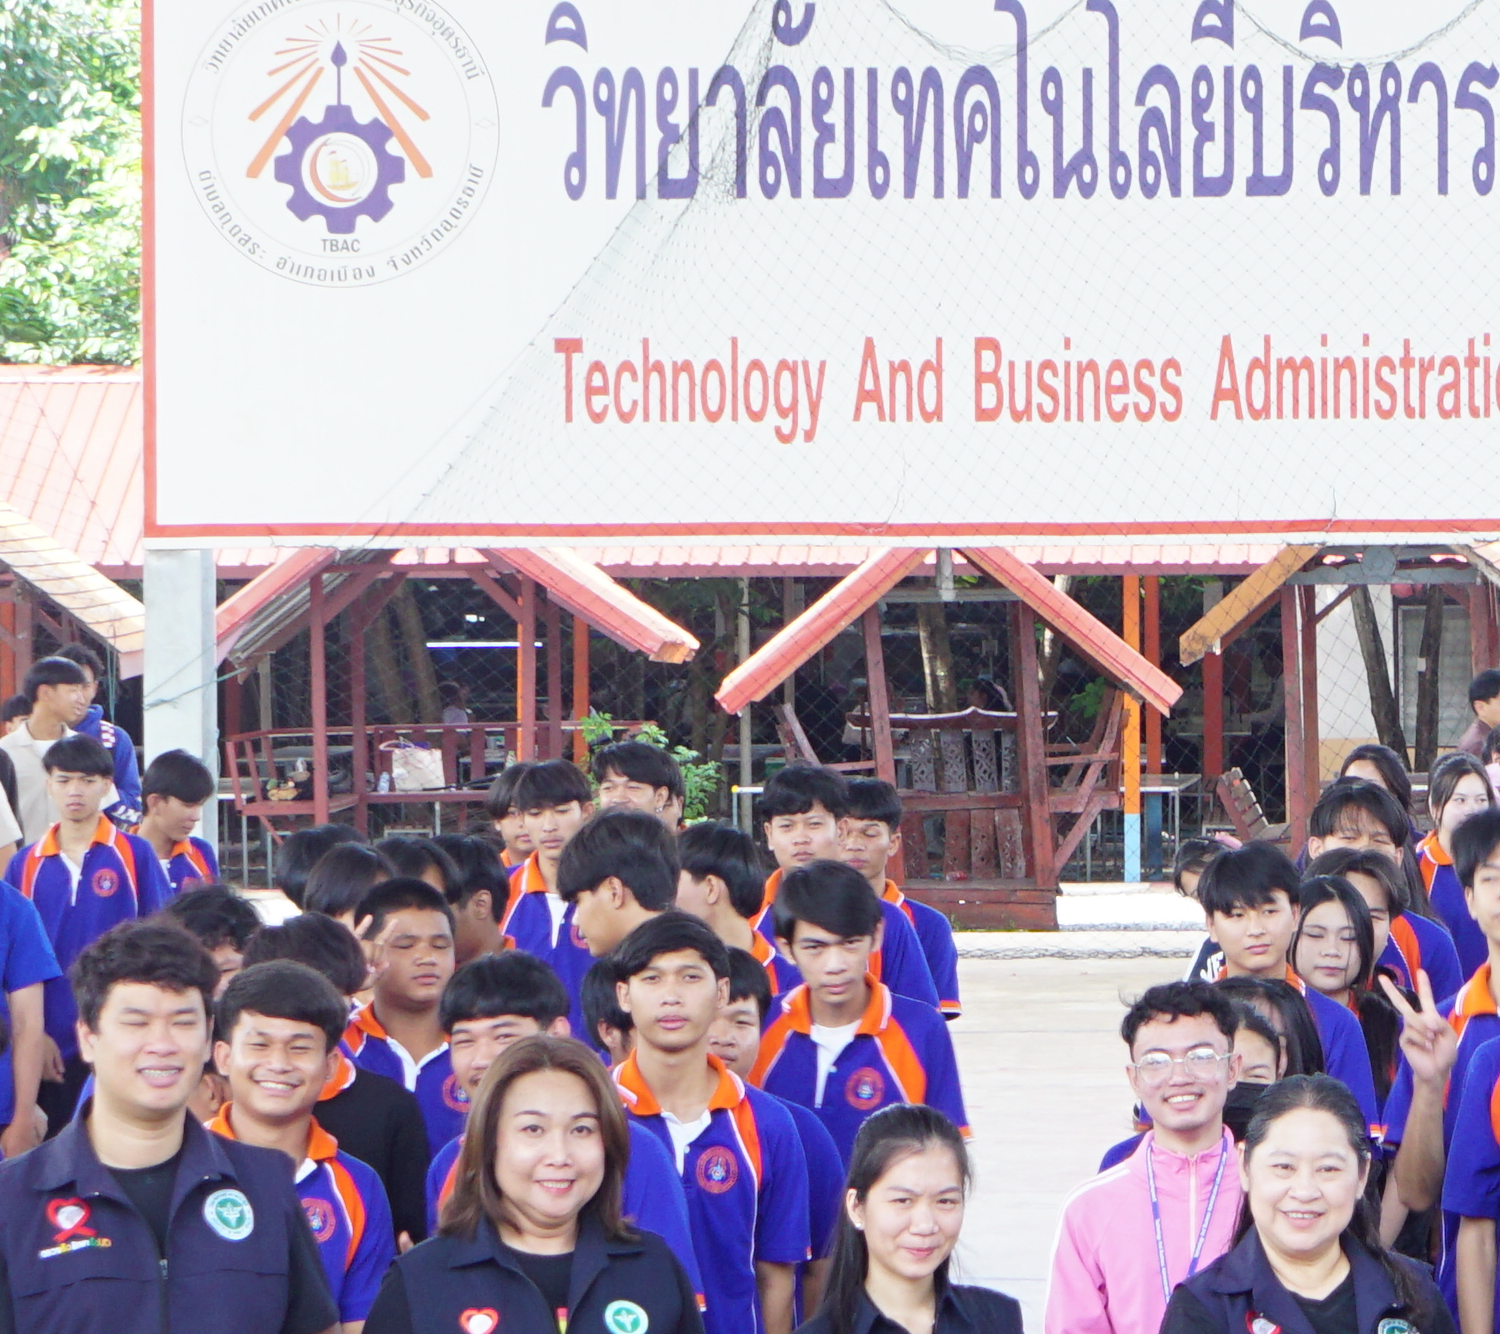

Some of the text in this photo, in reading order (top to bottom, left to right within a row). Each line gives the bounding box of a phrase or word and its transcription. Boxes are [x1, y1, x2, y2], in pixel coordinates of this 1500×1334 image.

[321, 238, 361, 253] TBAC
[553, 336, 827, 444] Technology
[851, 335, 944, 423] And
[973, 335, 1183, 424] Business
